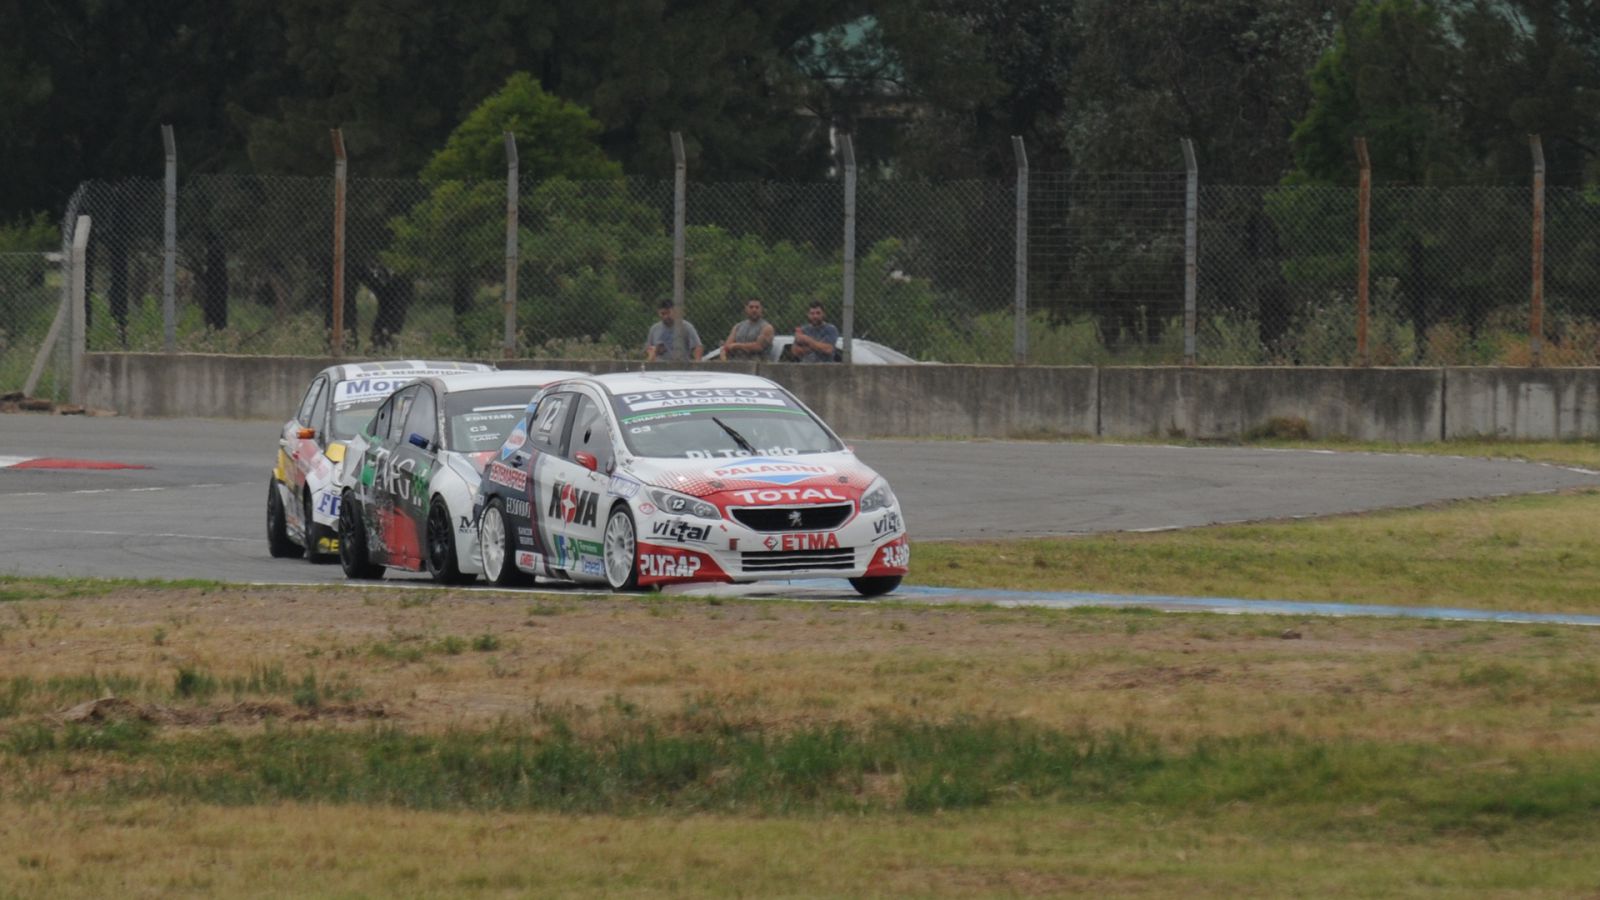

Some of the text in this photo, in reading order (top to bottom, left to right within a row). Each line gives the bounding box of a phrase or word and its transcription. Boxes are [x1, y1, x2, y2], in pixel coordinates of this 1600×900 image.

[621, 388, 778, 404] PEUGEOT
[661, 397, 758, 407] AUTOPLAN
[466, 413, 515, 421] FONTANA
[540, 399, 562, 431] 12
[714, 465, 829, 477] PALADINI
[734, 487, 848, 504] TOTAL
[671, 499, 685, 511] 12
[781, 532, 840, 551] ETMA
[639, 554, 701, 577] PLYRAP
